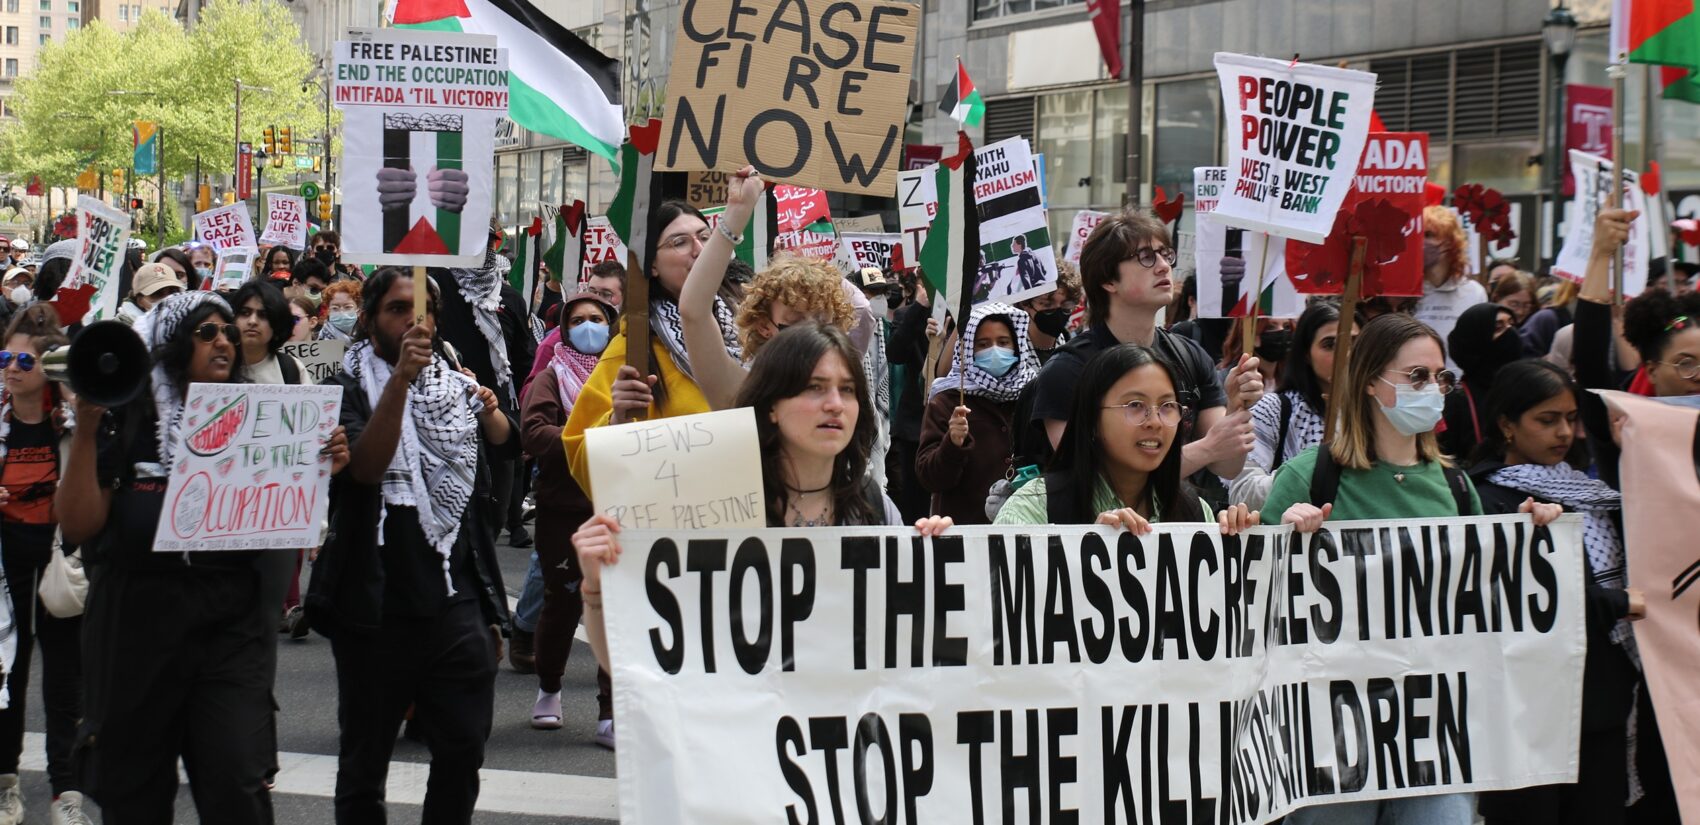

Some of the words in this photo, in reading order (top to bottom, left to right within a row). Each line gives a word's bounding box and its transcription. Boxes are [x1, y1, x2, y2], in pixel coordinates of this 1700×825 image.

[683, 0, 909, 73] CEASE
[351, 43, 394, 60] FREE
[401, 45, 498, 64] PALESTINE!
[338, 64, 370, 81] END
[376, 65, 407, 82] THE
[412, 67, 508, 86] OCCUPATION
[336, 86, 404, 103] INTIFADA
[443, 89, 508, 107] VICTORY!
[1238, 75, 1349, 130] PEOPLE
[667, 94, 898, 187] NOW
[1241, 115, 1341, 171] POWER
[976, 147, 1005, 167] WITH
[975, 160, 1010, 182] YAHU
[1241, 157, 1270, 183] WEST
[1284, 169, 1330, 195] WEST
[974, 170, 1034, 199] ERIALISM
[1197, 184, 1218, 196] END
[1234, 179, 1268, 203] PHILLY
[1280, 191, 1322, 214] BANK
[1357, 175, 1427, 193] VICTORY
[270, 211, 301, 223] GAZA
[275, 200, 294, 211] LET
[1197, 199, 1219, 211] INTI
[203, 223, 244, 241] GAZA
[207, 213, 231, 228] LET
[273, 222, 294, 233] LIVE
[277, 343, 320, 358] REE
[252, 400, 320, 438] END
[621, 422, 714, 456] JEWS
[238, 443, 266, 467] TO
[271, 441, 314, 471] THE
[654, 460, 680, 498] 4
[171, 471, 316, 539] OCCUPATION
[645, 535, 816, 676] STOP
[840, 534, 968, 671] THE
[987, 531, 1265, 666] MASSACRE
[776, 711, 934, 825] STOP
[957, 707, 1079, 825] THE
